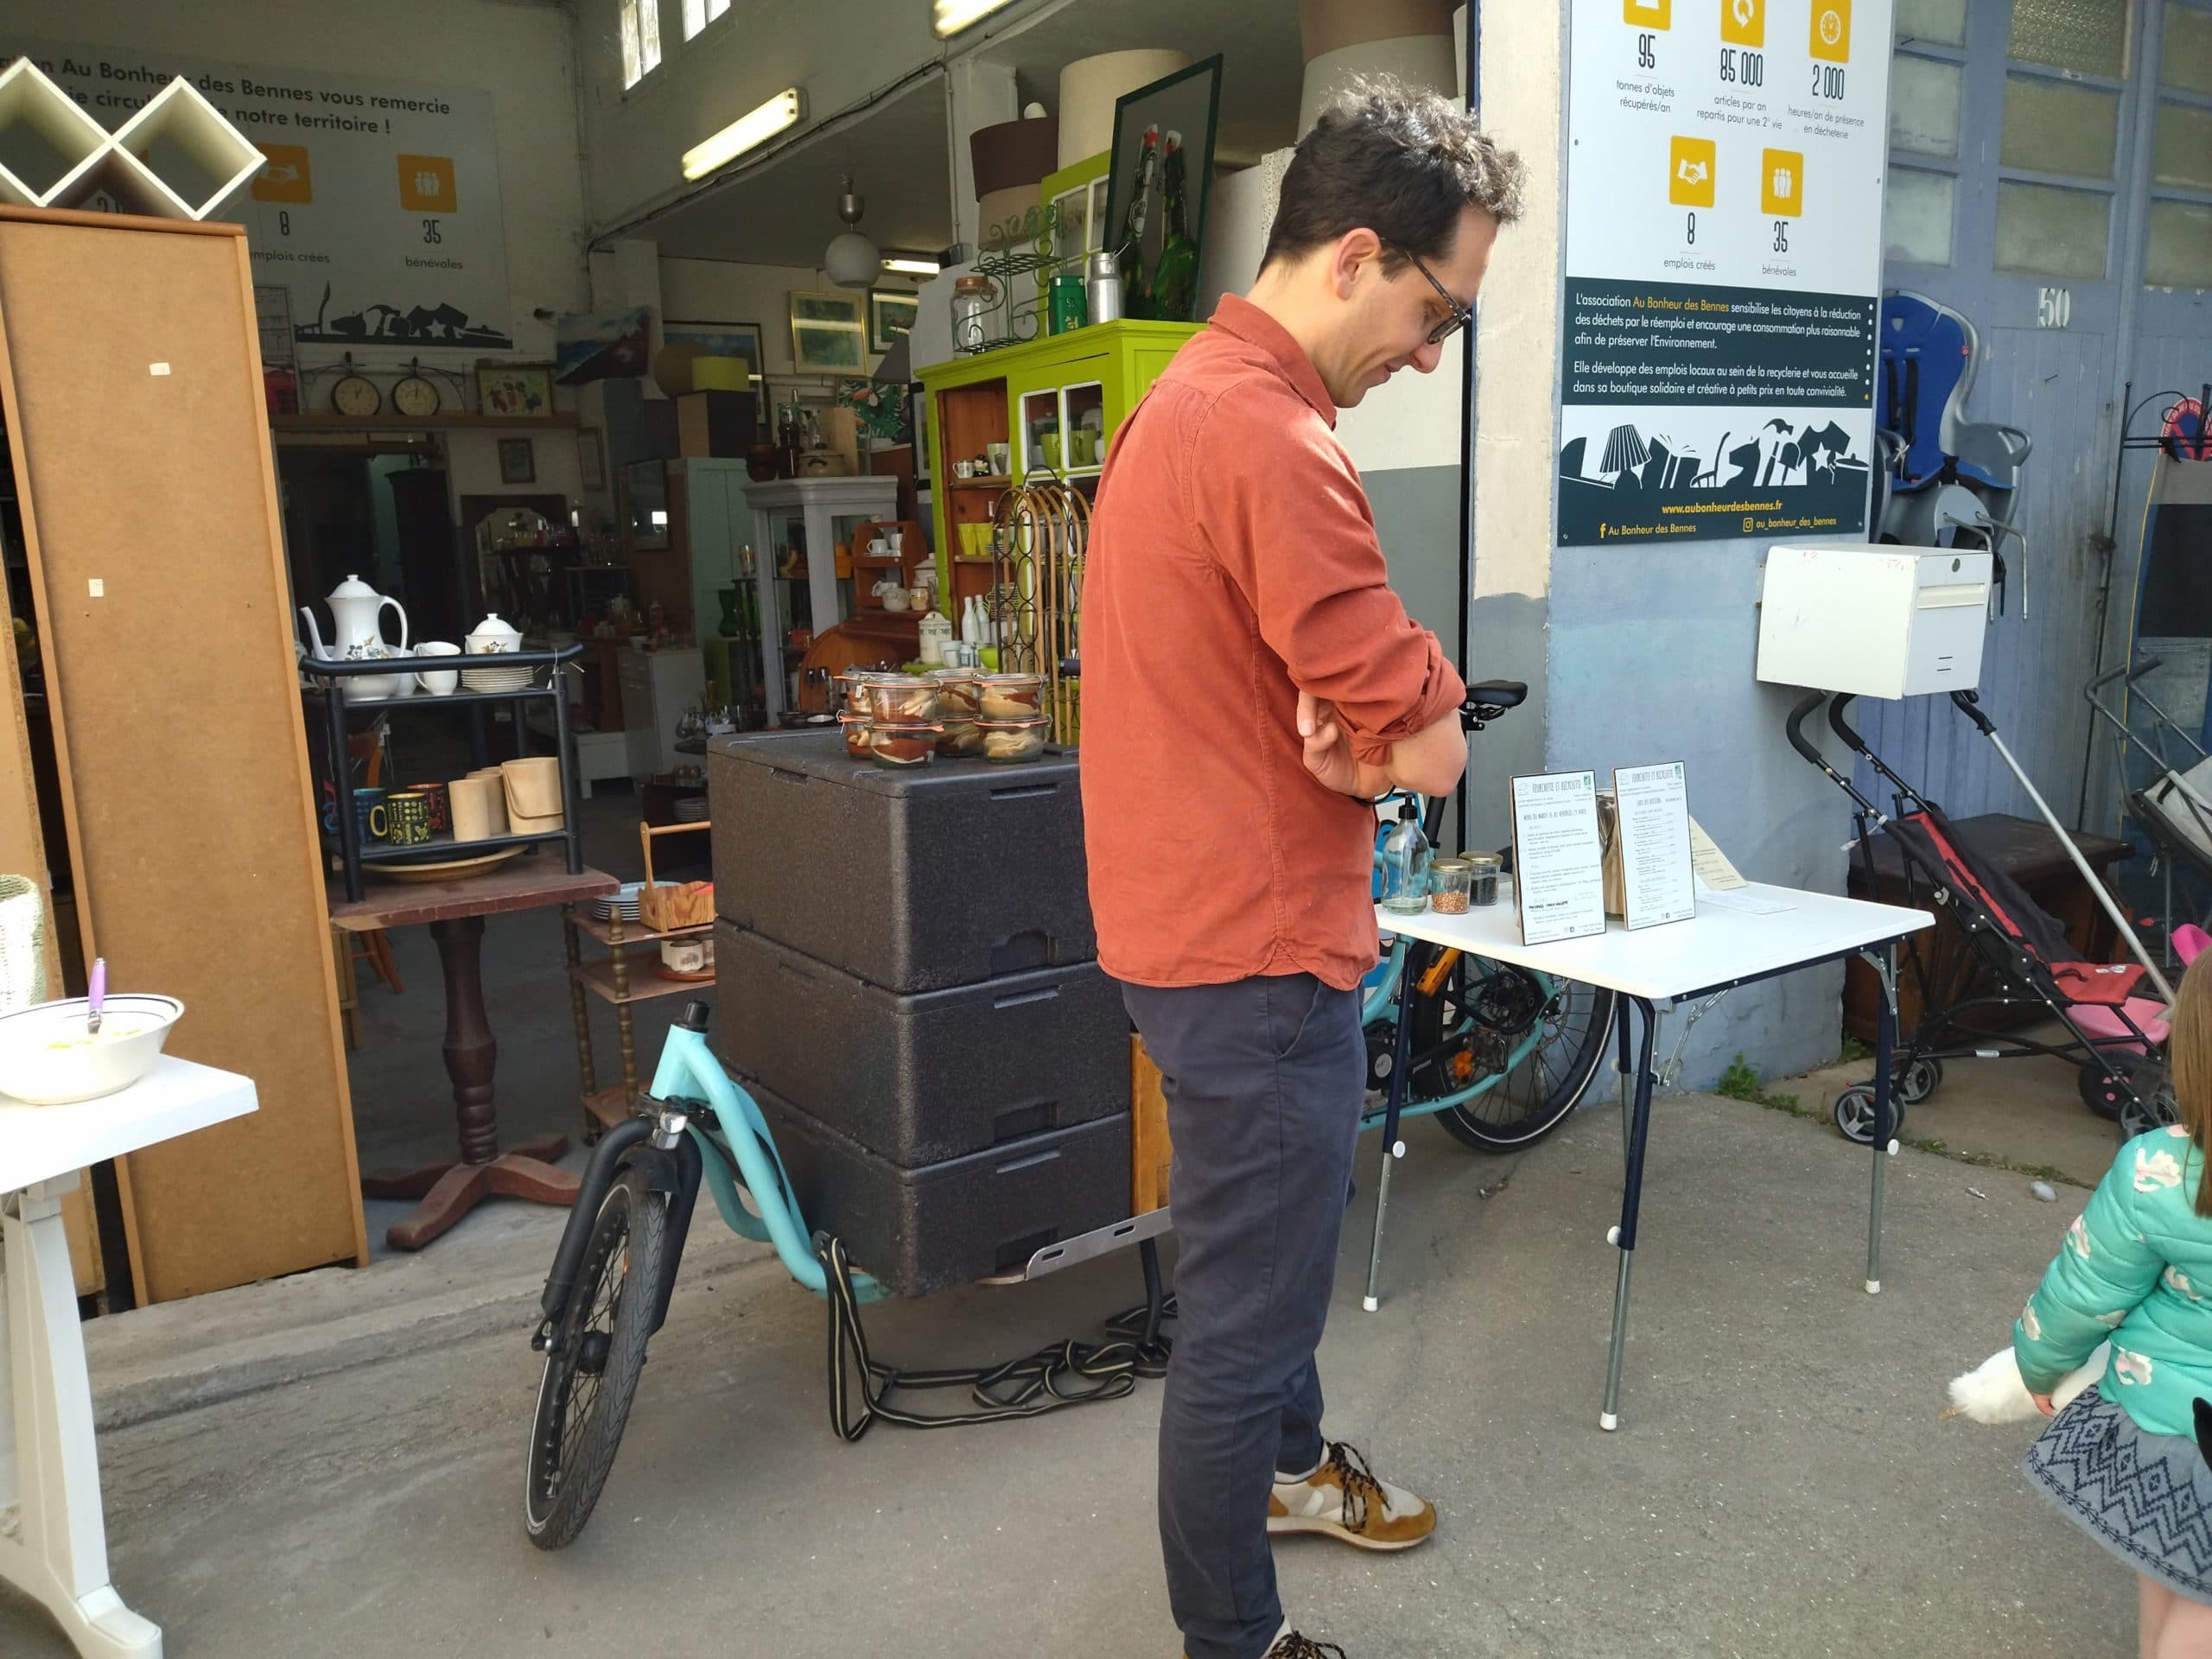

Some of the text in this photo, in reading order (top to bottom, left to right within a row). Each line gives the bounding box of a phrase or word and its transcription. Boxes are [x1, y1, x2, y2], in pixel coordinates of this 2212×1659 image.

[1638, 33, 1656, 69] 95
[1720, 48, 1764, 87] 85 000
[62, 59, 91, 77] Au
[199, 74, 234, 93] des
[241, 79, 313, 102] Bennes
[320, 91, 364, 106] vous
[370, 96, 450, 114] remercie
[1617, 79, 1643, 92] tonnes
[1812, 64, 1845, 100] 2 000
[1714, 95, 1767, 111] articles par an
[235, 109, 288, 125] notre
[295, 112, 378, 133] territoire
[385, 119, 391, 134] !
[1697, 109, 1726, 121] repartis
[1727, 114, 1745, 124] pour
[1746, 118, 1760, 126] une
[1771, 119, 1783, 130] vie
[1824, 112, 1834, 122] de
[1835, 113, 1865, 128] présence
[279, 211, 290, 236] 8
[423, 219, 442, 245] 35
[1688, 212, 1695, 245] 8
[1773, 221, 1789, 252] 35
[1663, 257, 1716, 270] emplois créés
[1762, 264, 1796, 276] bénévoles
[1576, 293, 1861, 321] L'association Au Bonheur des Bennes sensibilise les citoyens à la réduction
[2040, 288, 2069, 328] 50
[1575, 312, 1860, 338] des déchets par le réemploi et encourage une consommation plus raisonnable
[1574, 332, 1718, 349] afin de préserver l'Environnement.
[1573, 360, 1859, 380] Elle développe des emplois locaux au sein de la recyclerie et vous accueille
[1573, 380, 1847, 397] dans sa boutique solidaire et créative à petits prix en toute convivialité.
[1662, 499, 1783, 514] www.aubonheurdesbennes.fr
[1608, 526, 1619, 536] Au
[1621, 524, 1653, 535] Bonheur
[1655, 524, 1668, 534] des
[1670, 524, 1697, 533] Bennes
[1756, 517, 1837, 531] au_bonheur_des_bennes
